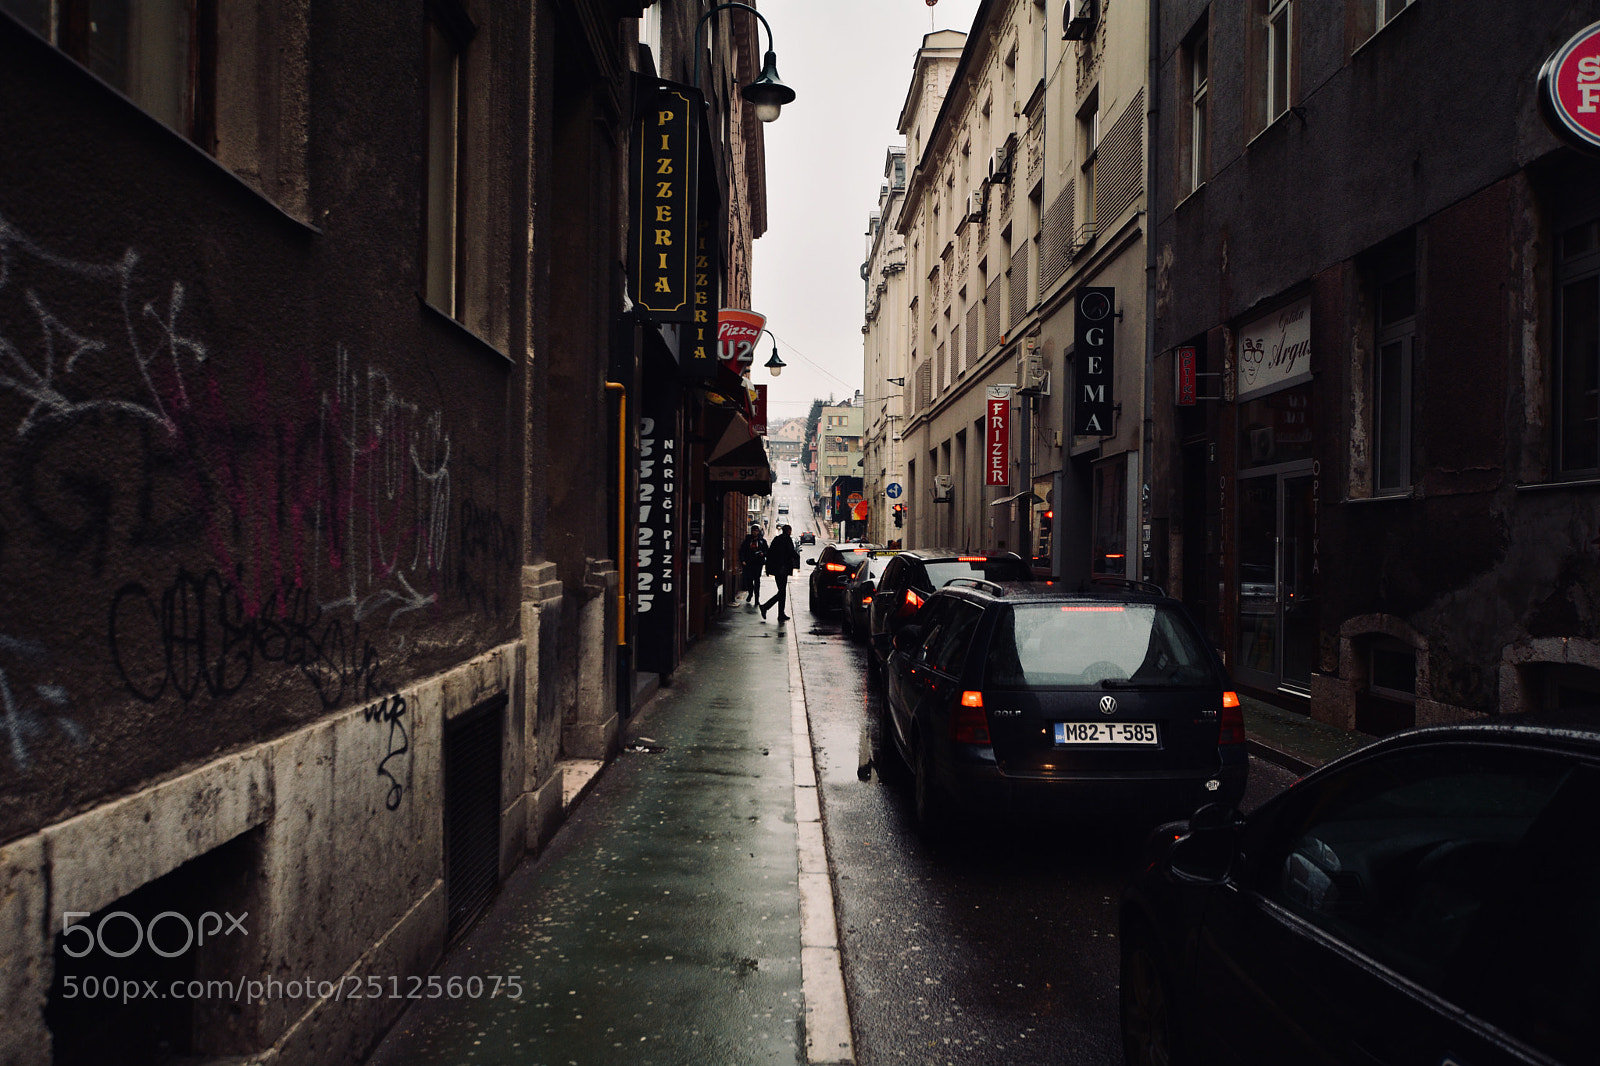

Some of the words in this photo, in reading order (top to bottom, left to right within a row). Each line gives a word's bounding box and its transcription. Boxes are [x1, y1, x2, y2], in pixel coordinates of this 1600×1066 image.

[654, 110, 675, 293] PIZZERIA
[694, 219, 709, 359] PIZZERIA
[717, 322, 758, 340] Pizza
[717, 340, 753, 361] U2
[1083, 327, 1105, 431] GEMA
[1180, 350, 1194, 403] OPTIKA
[662, 439, 674, 524] NARUČI
[991, 403, 1004, 482] FRIZER
[1312, 459, 1321, 576] OPTIKA
[662, 529, 673, 593] PIZZU
[1065, 724, 1155, 742] M82-T-585
